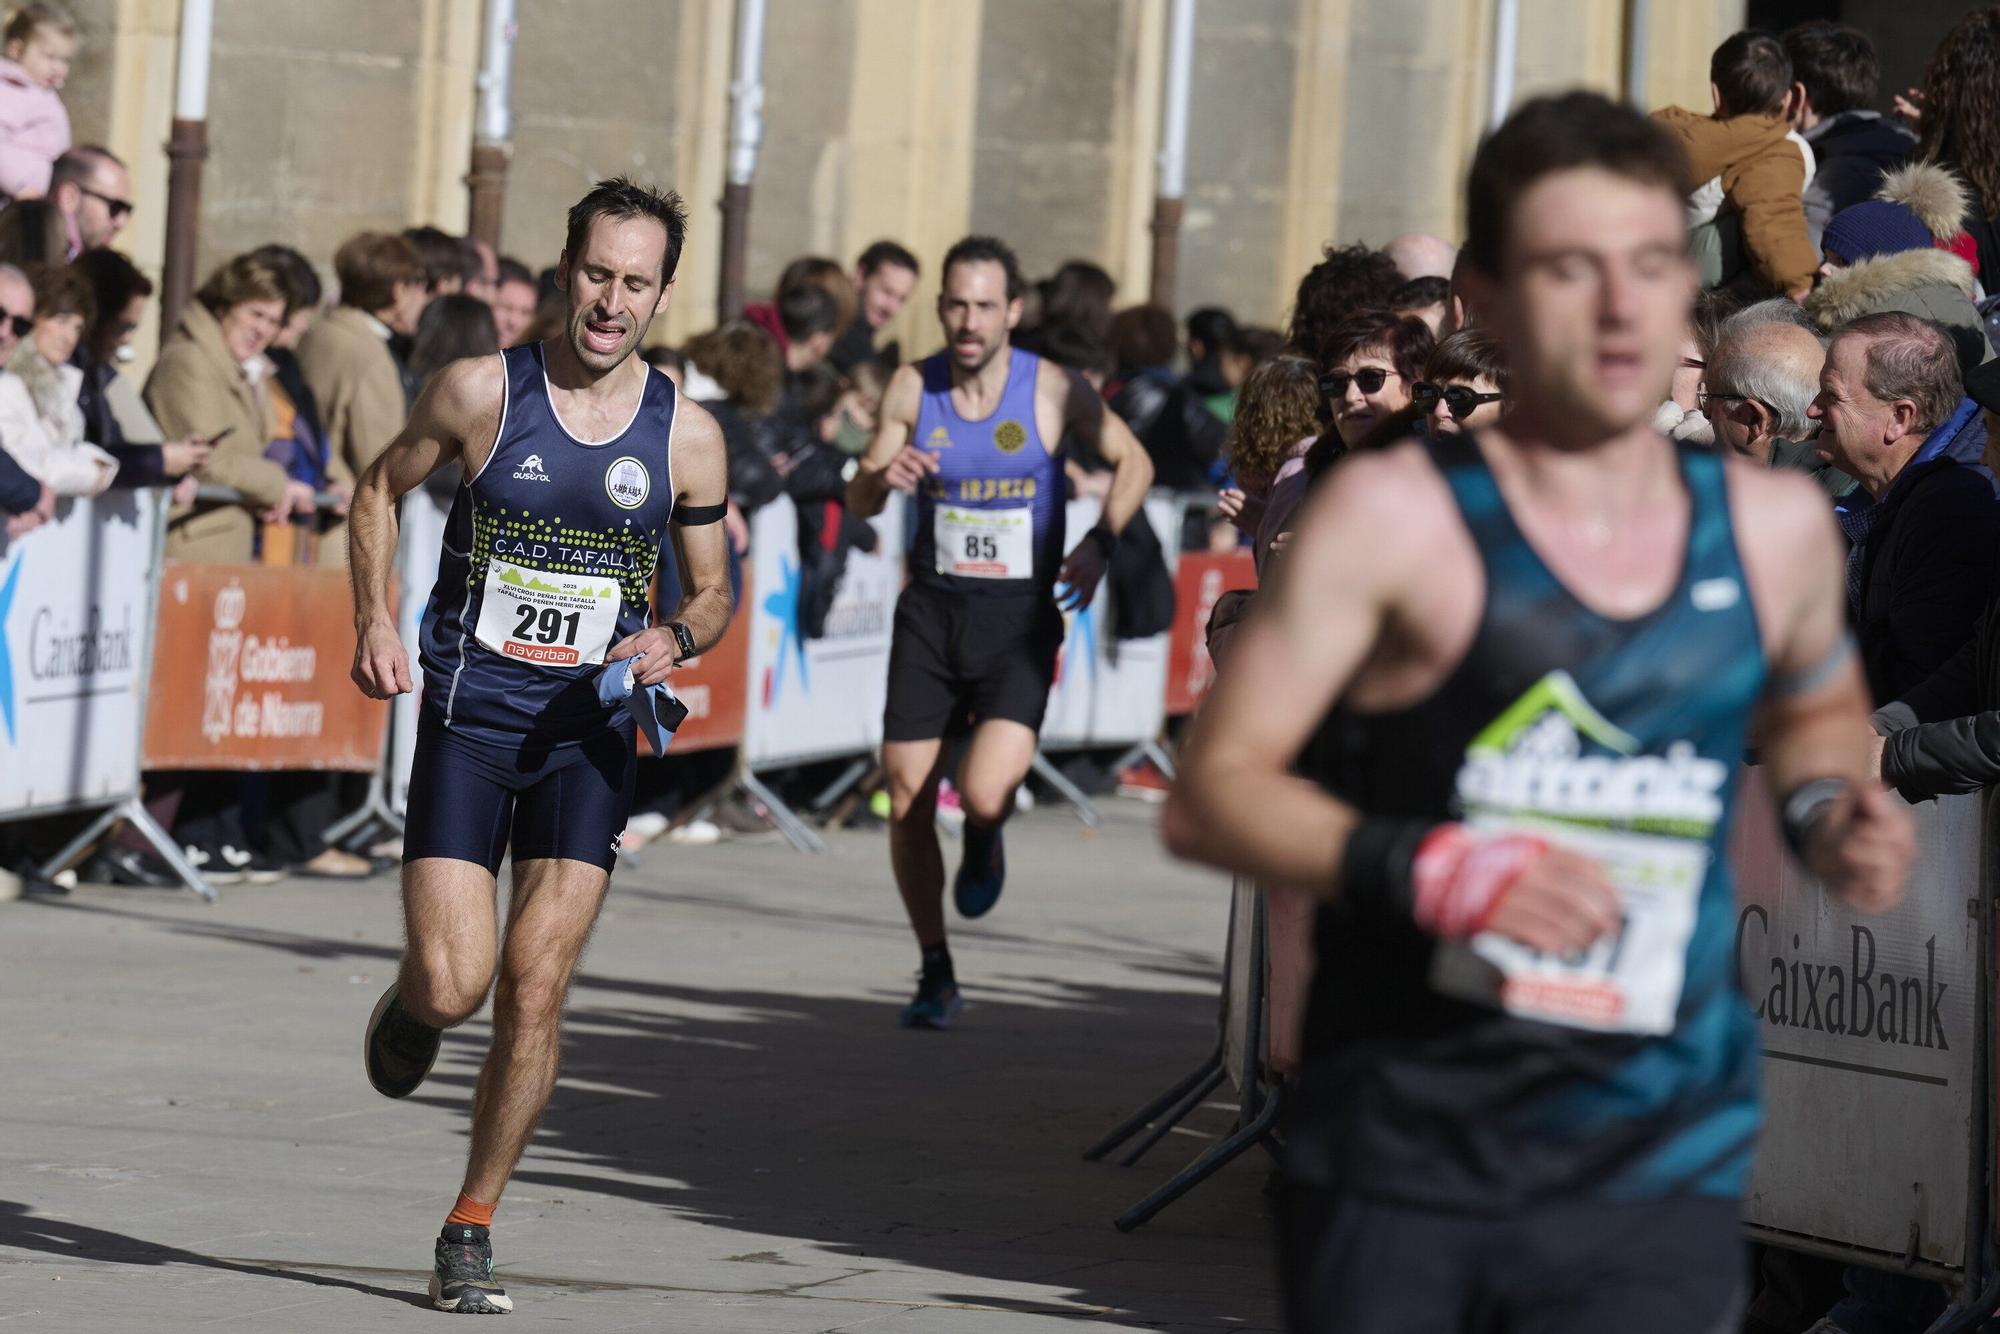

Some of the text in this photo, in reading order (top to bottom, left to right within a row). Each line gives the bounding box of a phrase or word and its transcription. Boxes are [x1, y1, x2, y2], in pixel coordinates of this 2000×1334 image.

[495, 539, 552, 560] C.A.D.
[965, 535, 997, 560] 85
[497, 588, 532, 603] TAFALLAKO
[532, 597, 555, 606] PEÑEN
[555, 601, 574, 609] HERRI
[503, 584, 517, 592] XLVI
[517, 587, 535, 597] CROSS
[537, 592, 557, 600] PEÑAS
[569, 596, 597, 605] TAFALLA
[512, 604, 581, 646] 291
[30, 605, 132, 681] CaixaBank
[240, 635, 317, 682] Gobierno
[506, 643, 577, 662] navarban
[235, 691, 261, 737] de
[1736, 902, 1950, 1051] CaixaBank
